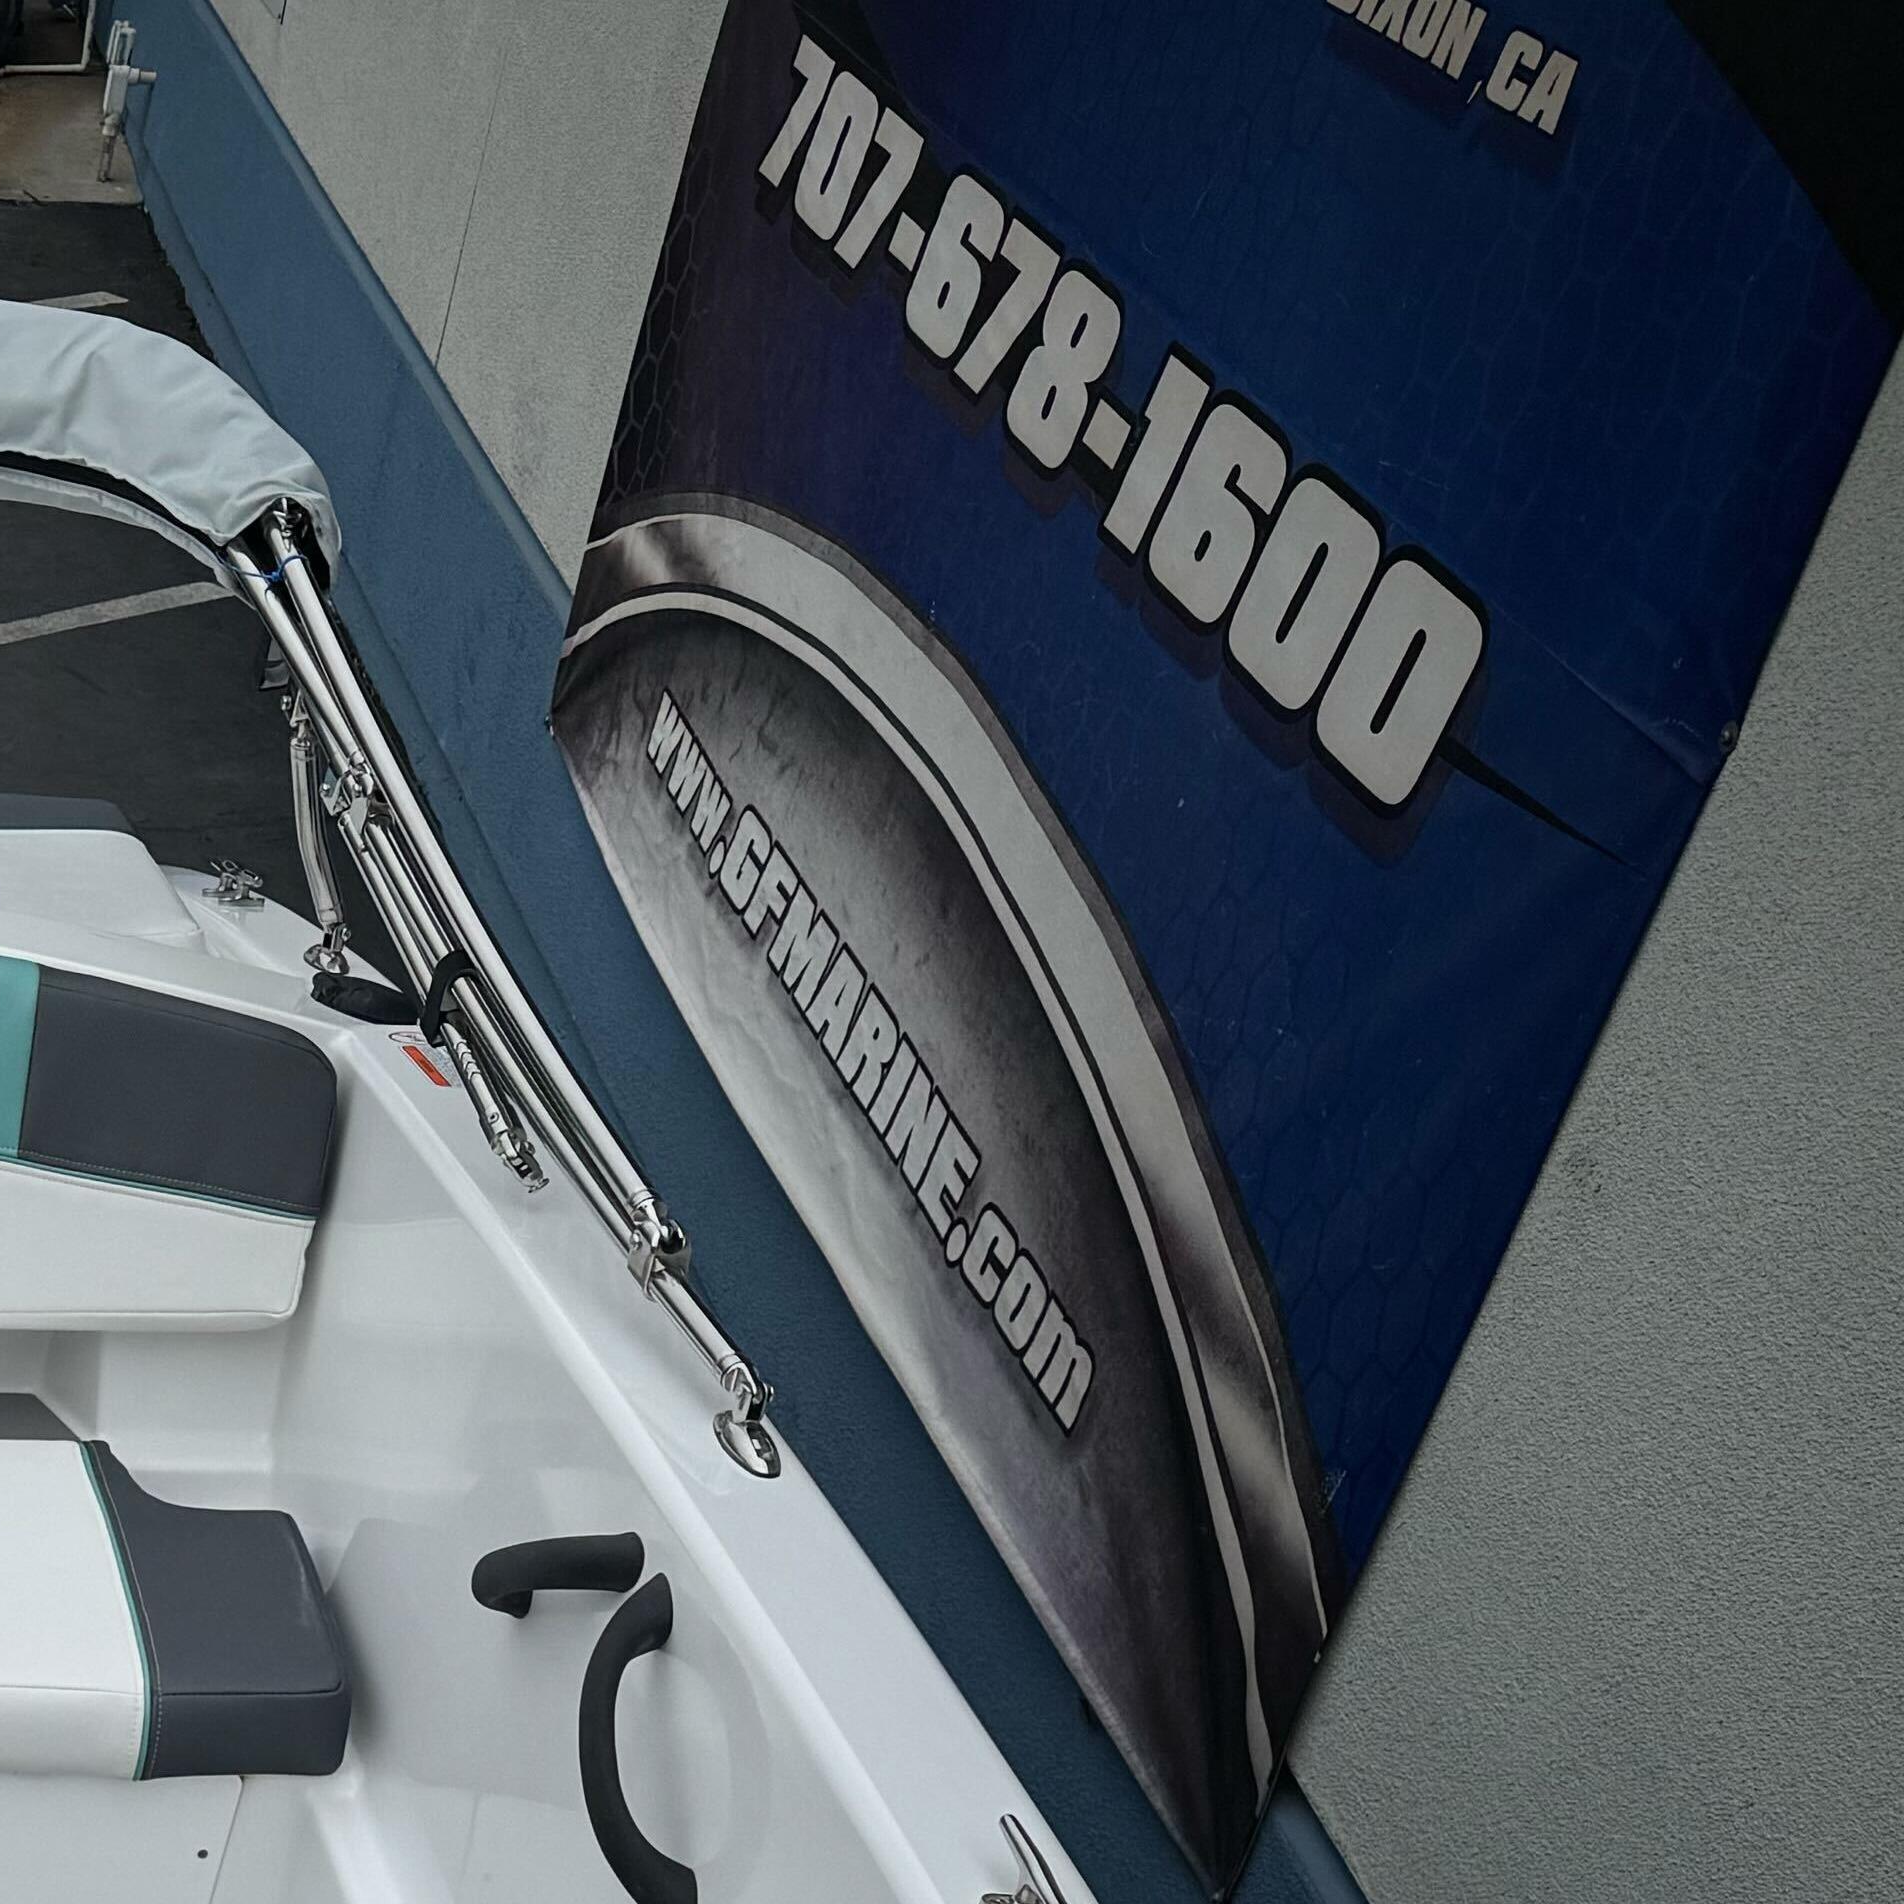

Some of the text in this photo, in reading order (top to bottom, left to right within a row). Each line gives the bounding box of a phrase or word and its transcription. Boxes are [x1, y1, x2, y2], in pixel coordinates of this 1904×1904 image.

[1326, 0, 1579, 135] XON, CA
[758, 34, 1483, 804] 707-678-1600
